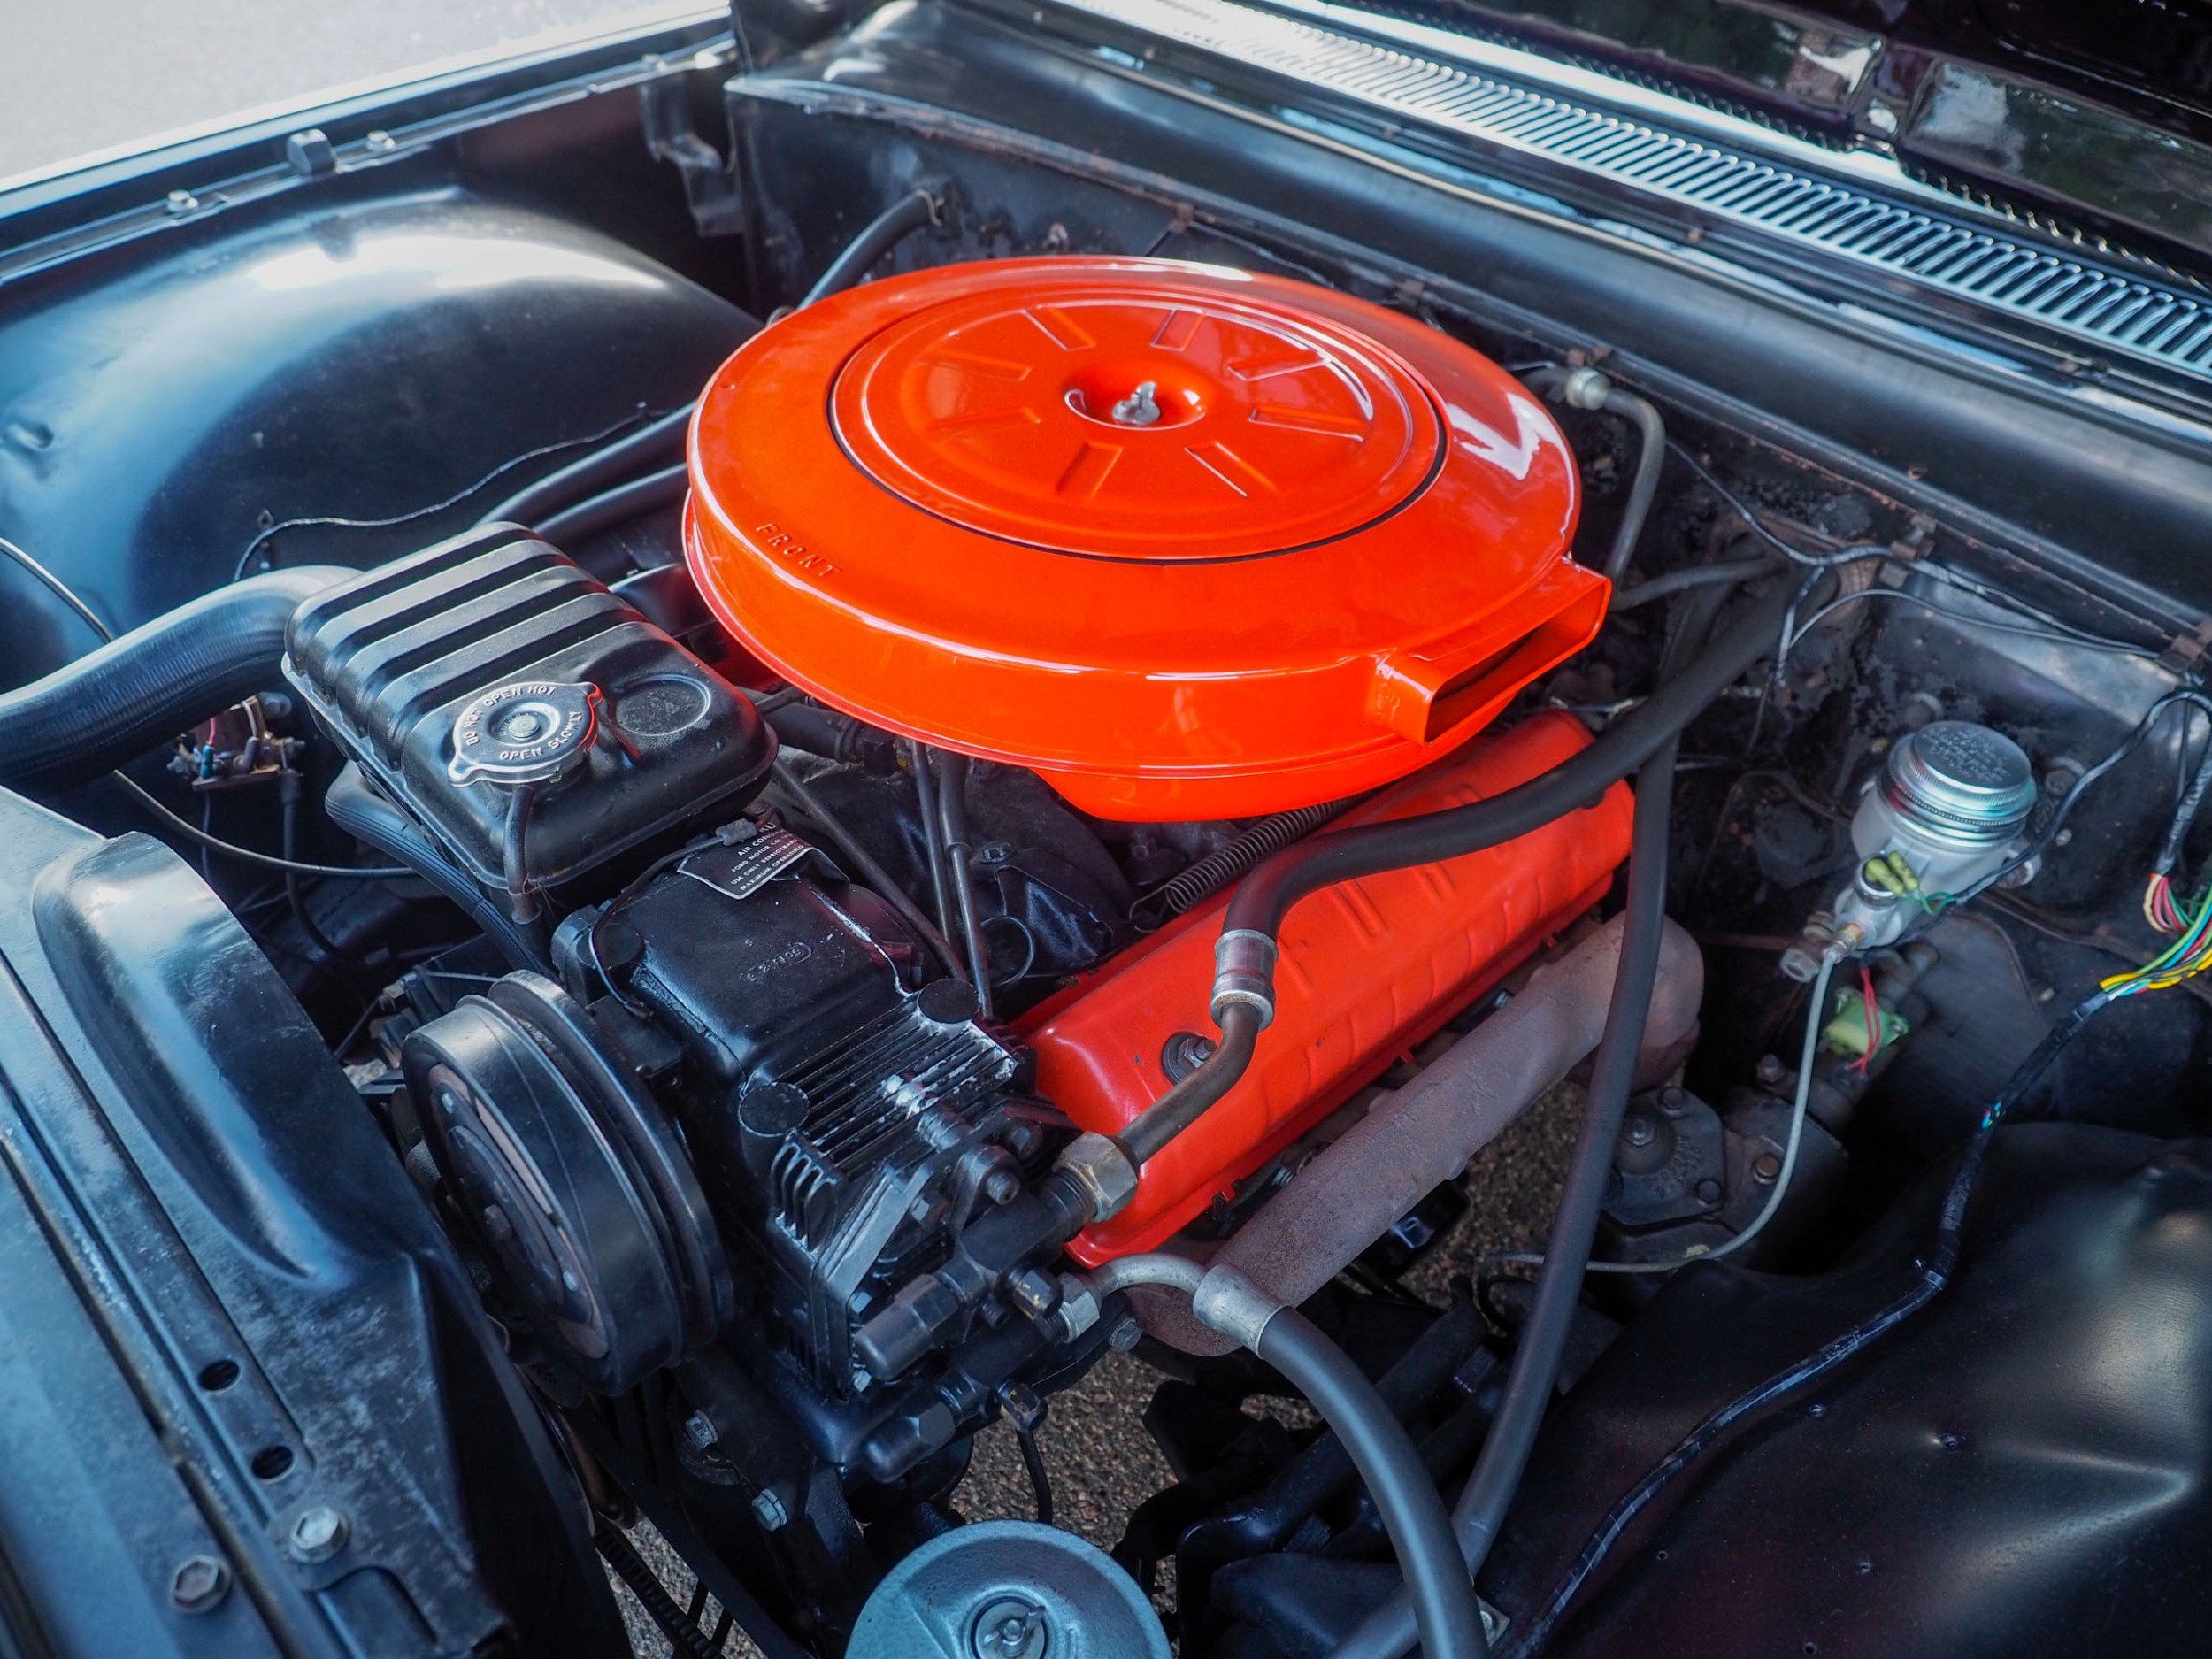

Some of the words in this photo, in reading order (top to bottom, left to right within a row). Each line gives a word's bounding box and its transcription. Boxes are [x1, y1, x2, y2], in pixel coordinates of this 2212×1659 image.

[756, 523, 843, 577] FRONT
[483, 687, 524, 708] OPEN
[527, 685, 557, 697] HOT
[464, 708, 484, 729] NOT
[464, 731, 480, 747] DO
[499, 746, 544, 761] OPEN
[547, 710, 584, 749] SLOWLY
[731, 859, 749, 872] FORD
[749, 844, 772, 861] MOTOR
[731, 875, 744, 885] USE
[743, 863, 762, 876] ONLY
[761, 838, 799, 864] REFRIGERANT
[737, 846, 753, 857] AIR
[740, 866, 772, 891] MAXIMUM
[772, 844, 805, 868] OPERATING
